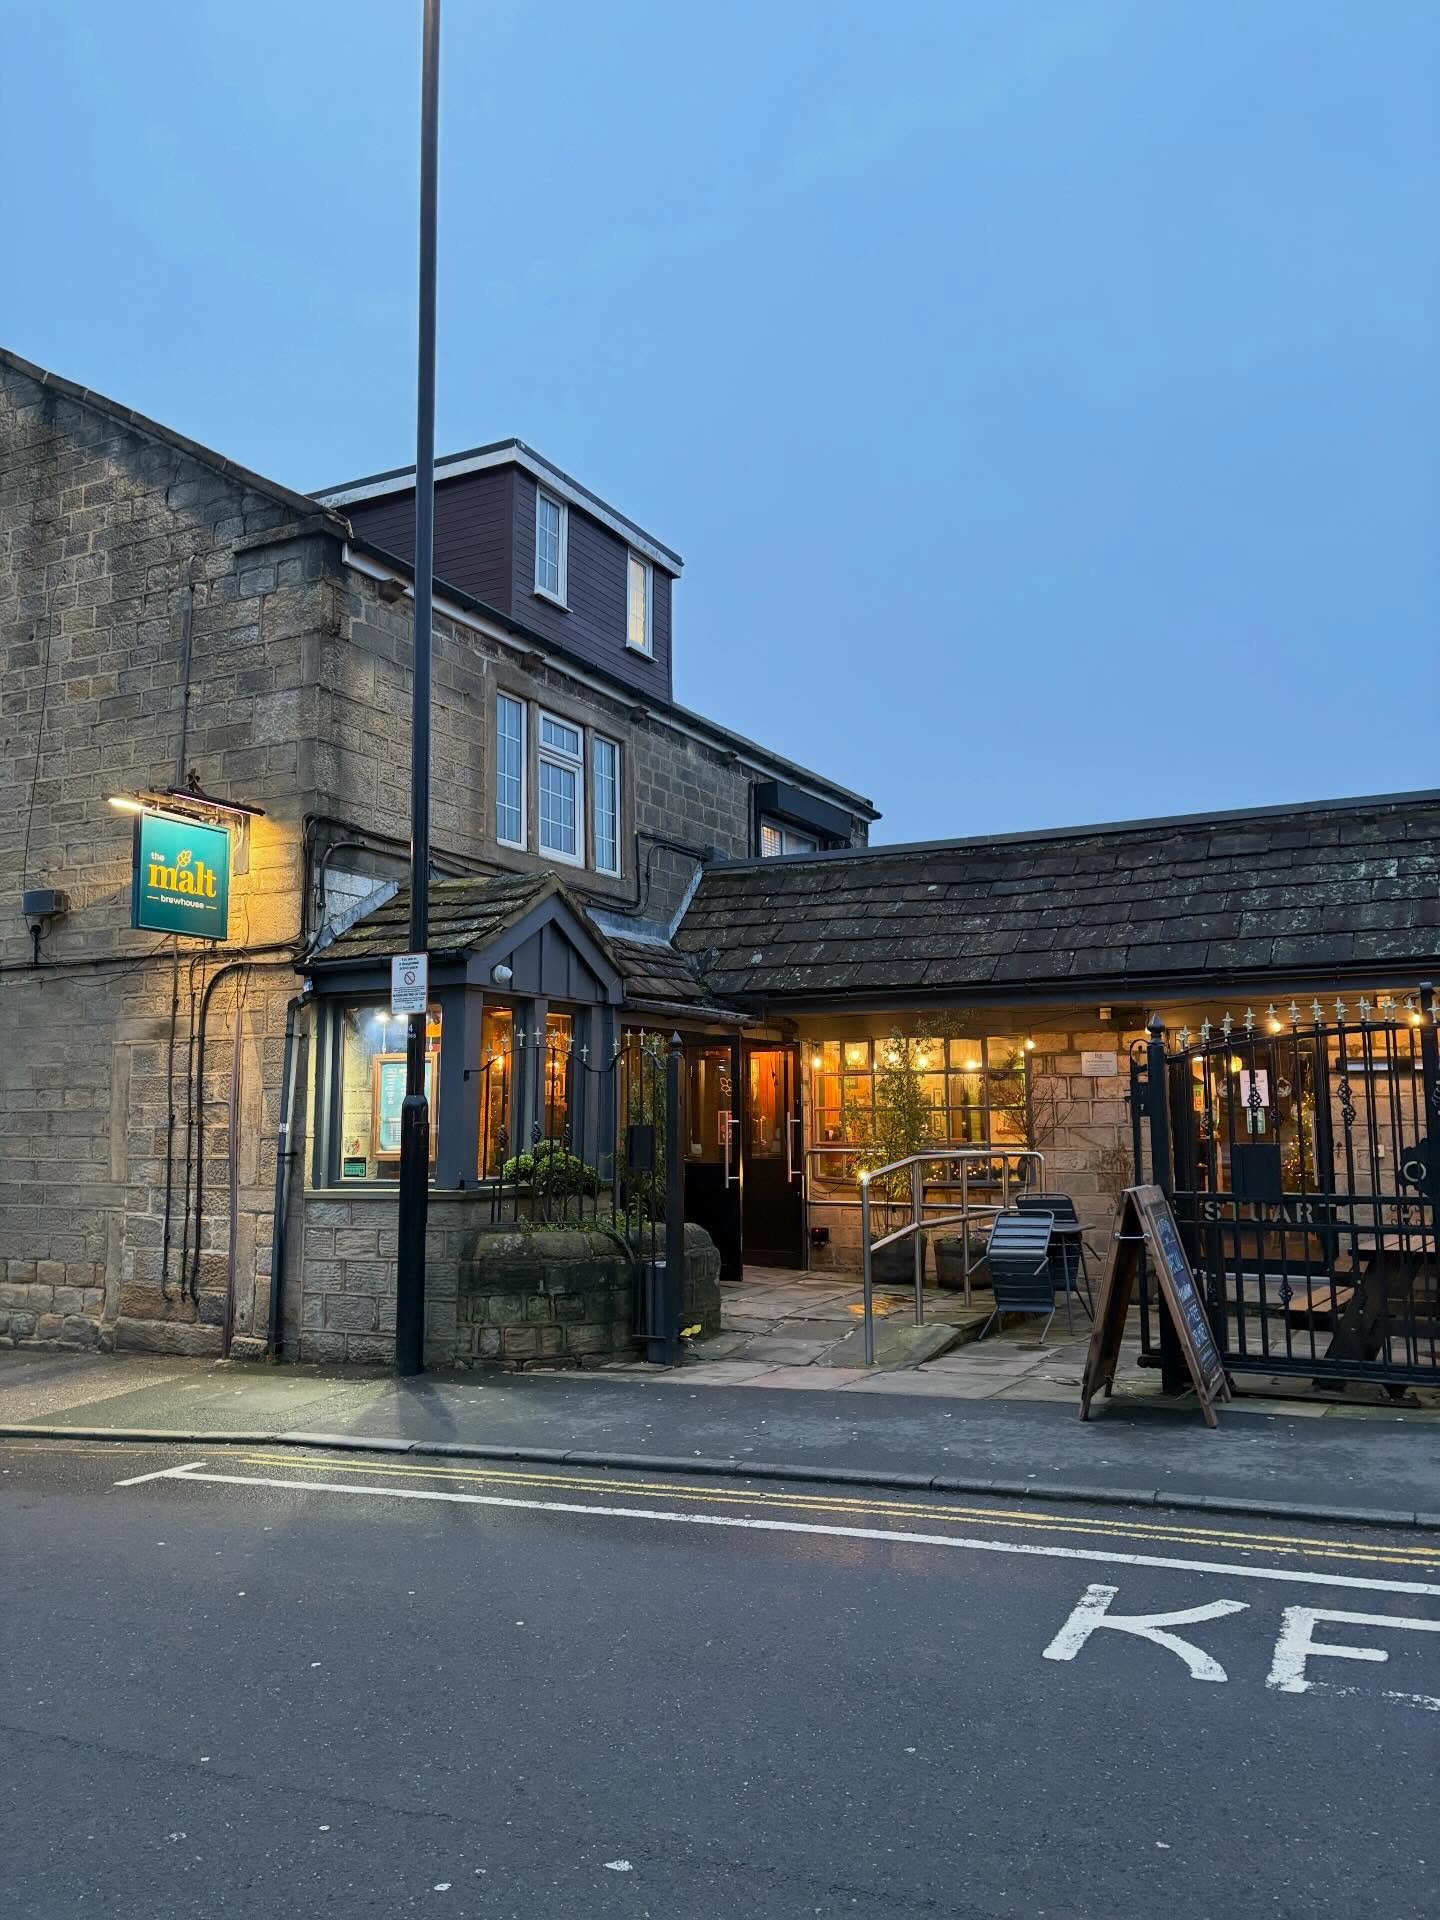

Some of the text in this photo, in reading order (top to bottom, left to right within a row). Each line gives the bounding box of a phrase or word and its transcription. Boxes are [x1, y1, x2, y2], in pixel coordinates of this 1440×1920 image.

[150, 851, 165, 862] the
[147, 861, 217, 898] malt
[160, 894, 205, 909] brewhouse
